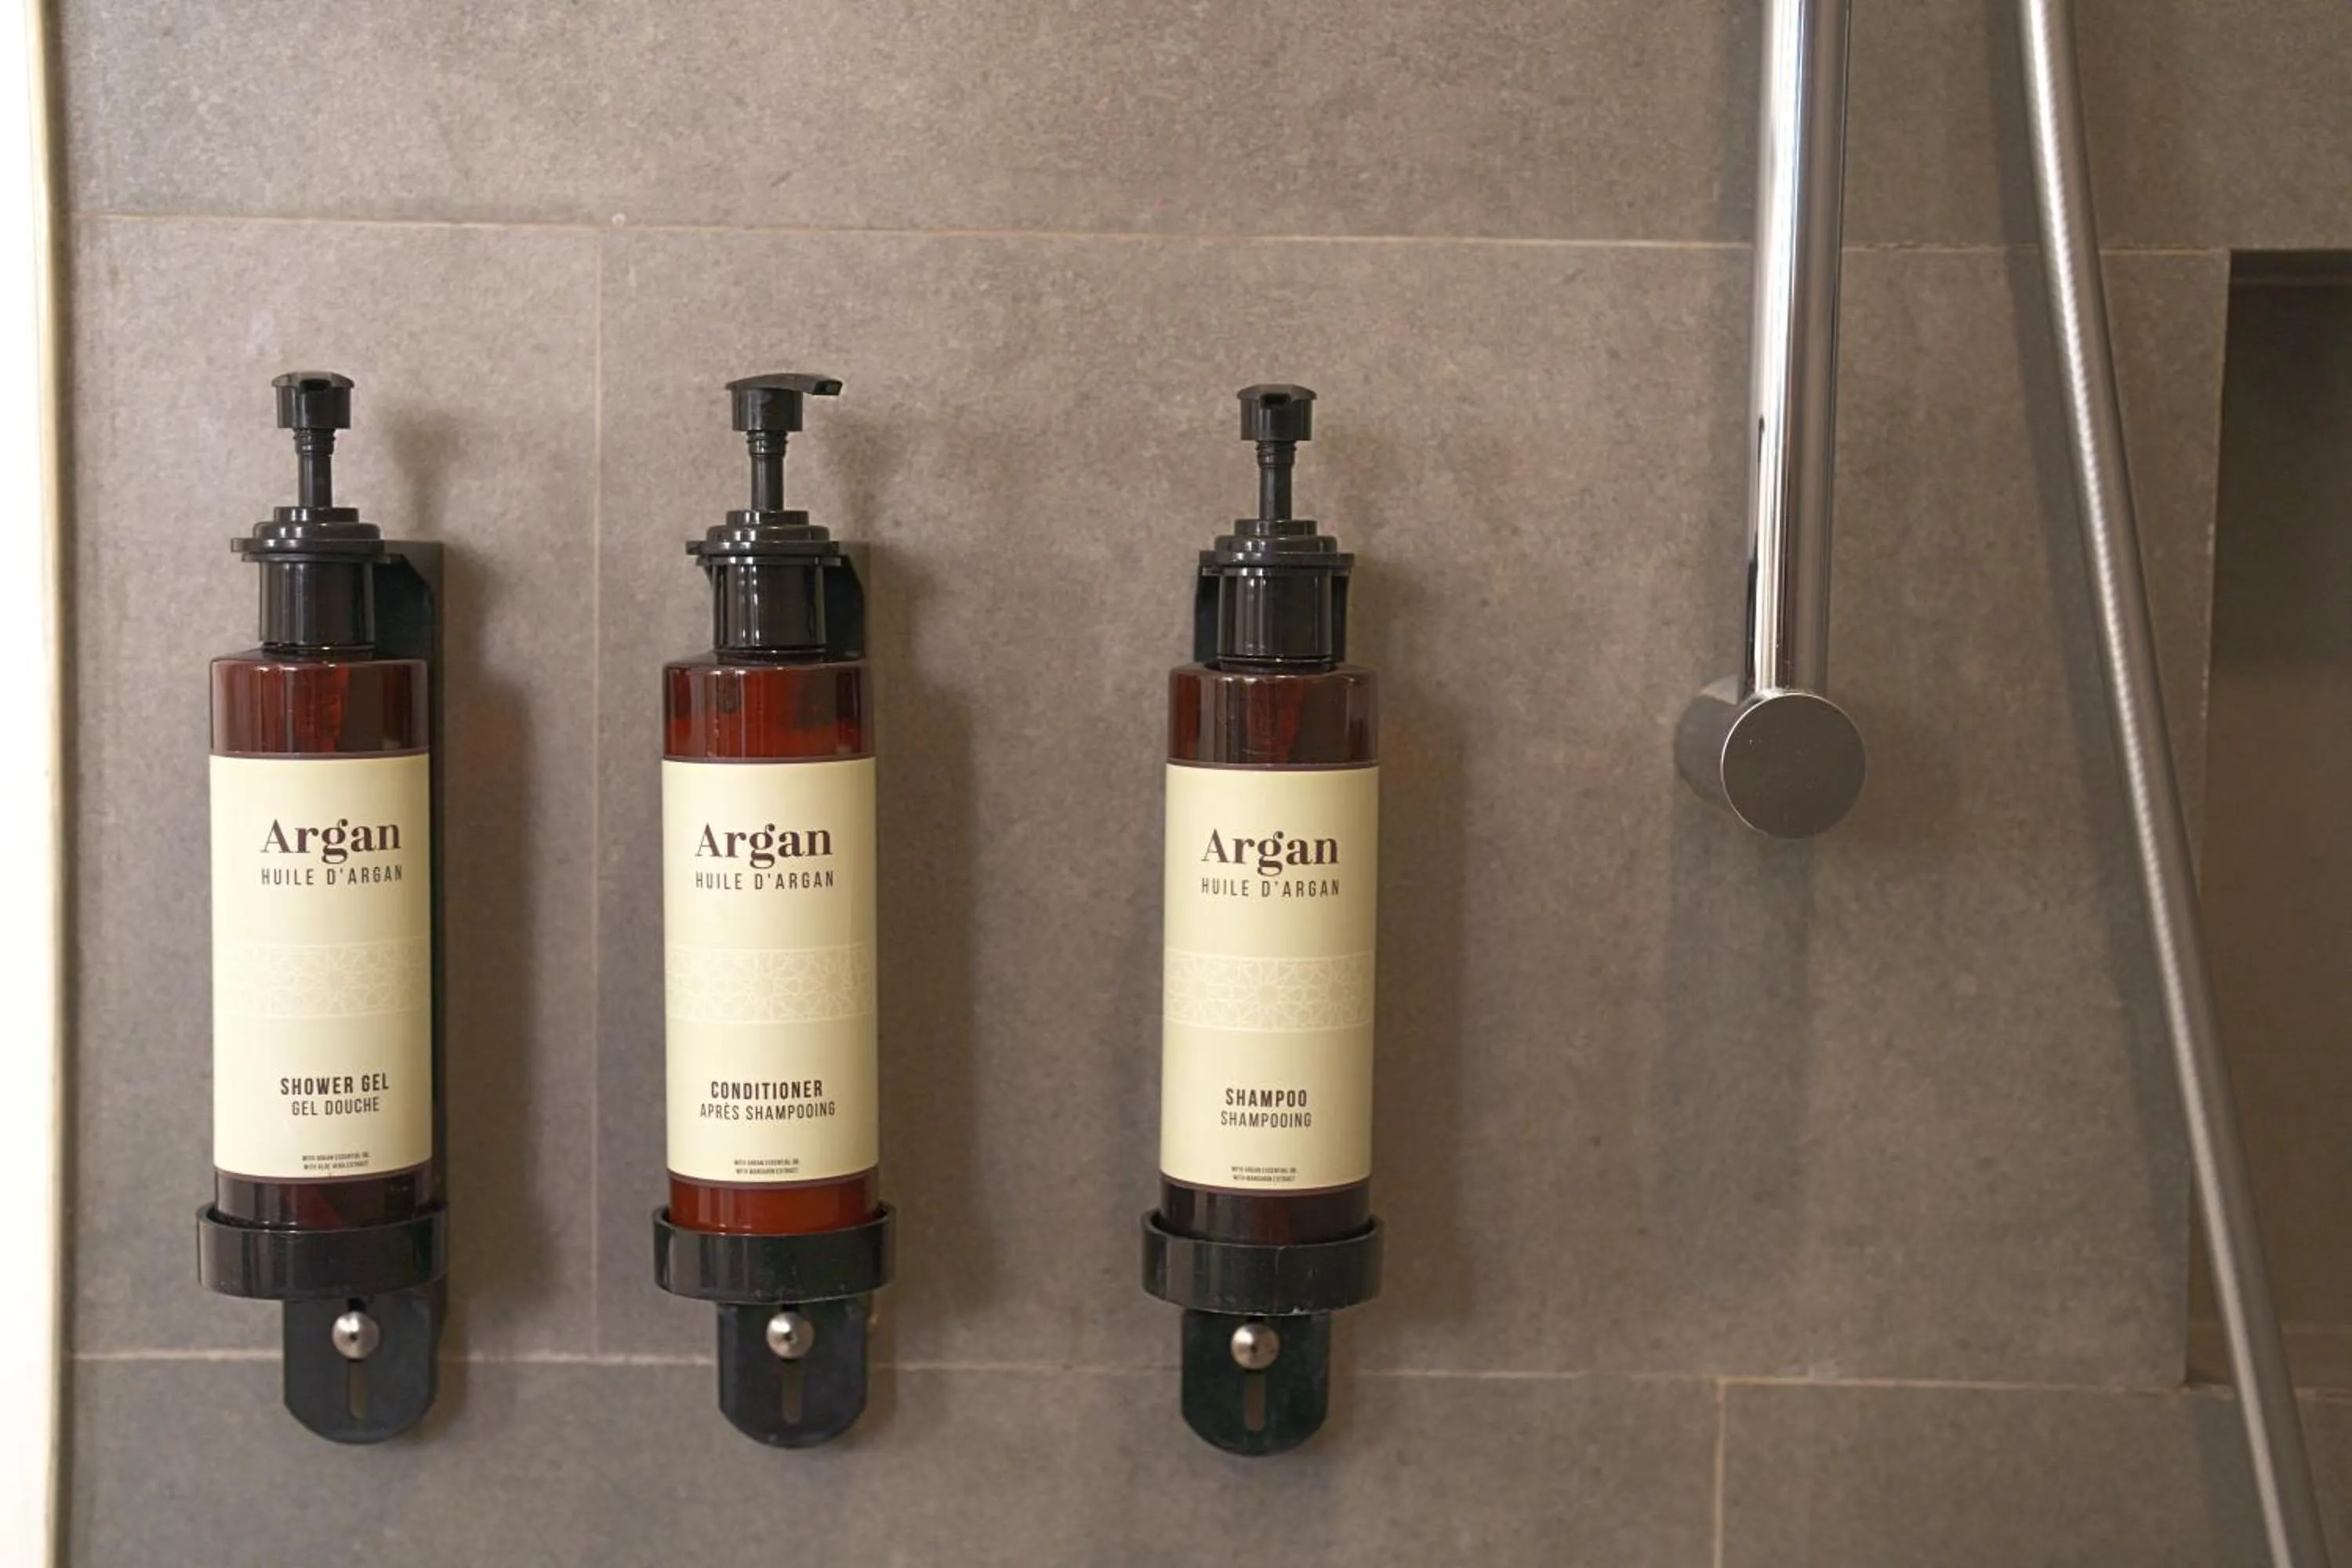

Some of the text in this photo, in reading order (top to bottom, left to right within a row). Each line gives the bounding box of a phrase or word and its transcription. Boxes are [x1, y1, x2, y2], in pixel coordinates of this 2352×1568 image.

[260, 818, 402, 865] Argan
[695, 822, 833, 869] Argan
[1200, 828, 1340, 877] Argan
[261, 865, 403, 886] HUILE D'ARGAN
[695, 870, 834, 890] HUILE D'ARGAN
[1201, 877, 1340, 898] HUILE D'ARGAN
[280, 1073, 390, 1095] SHOWER GEL
[710, 1080, 823, 1100] CONDITIONER
[291, 1097, 380, 1116] GEL DOUCHE
[1225, 1087, 1308, 1107] SHAMPOO
[746, 1102, 836, 1120] SHAMPOOING
[1220, 1110, 1312, 1128] SHAMPOOING
